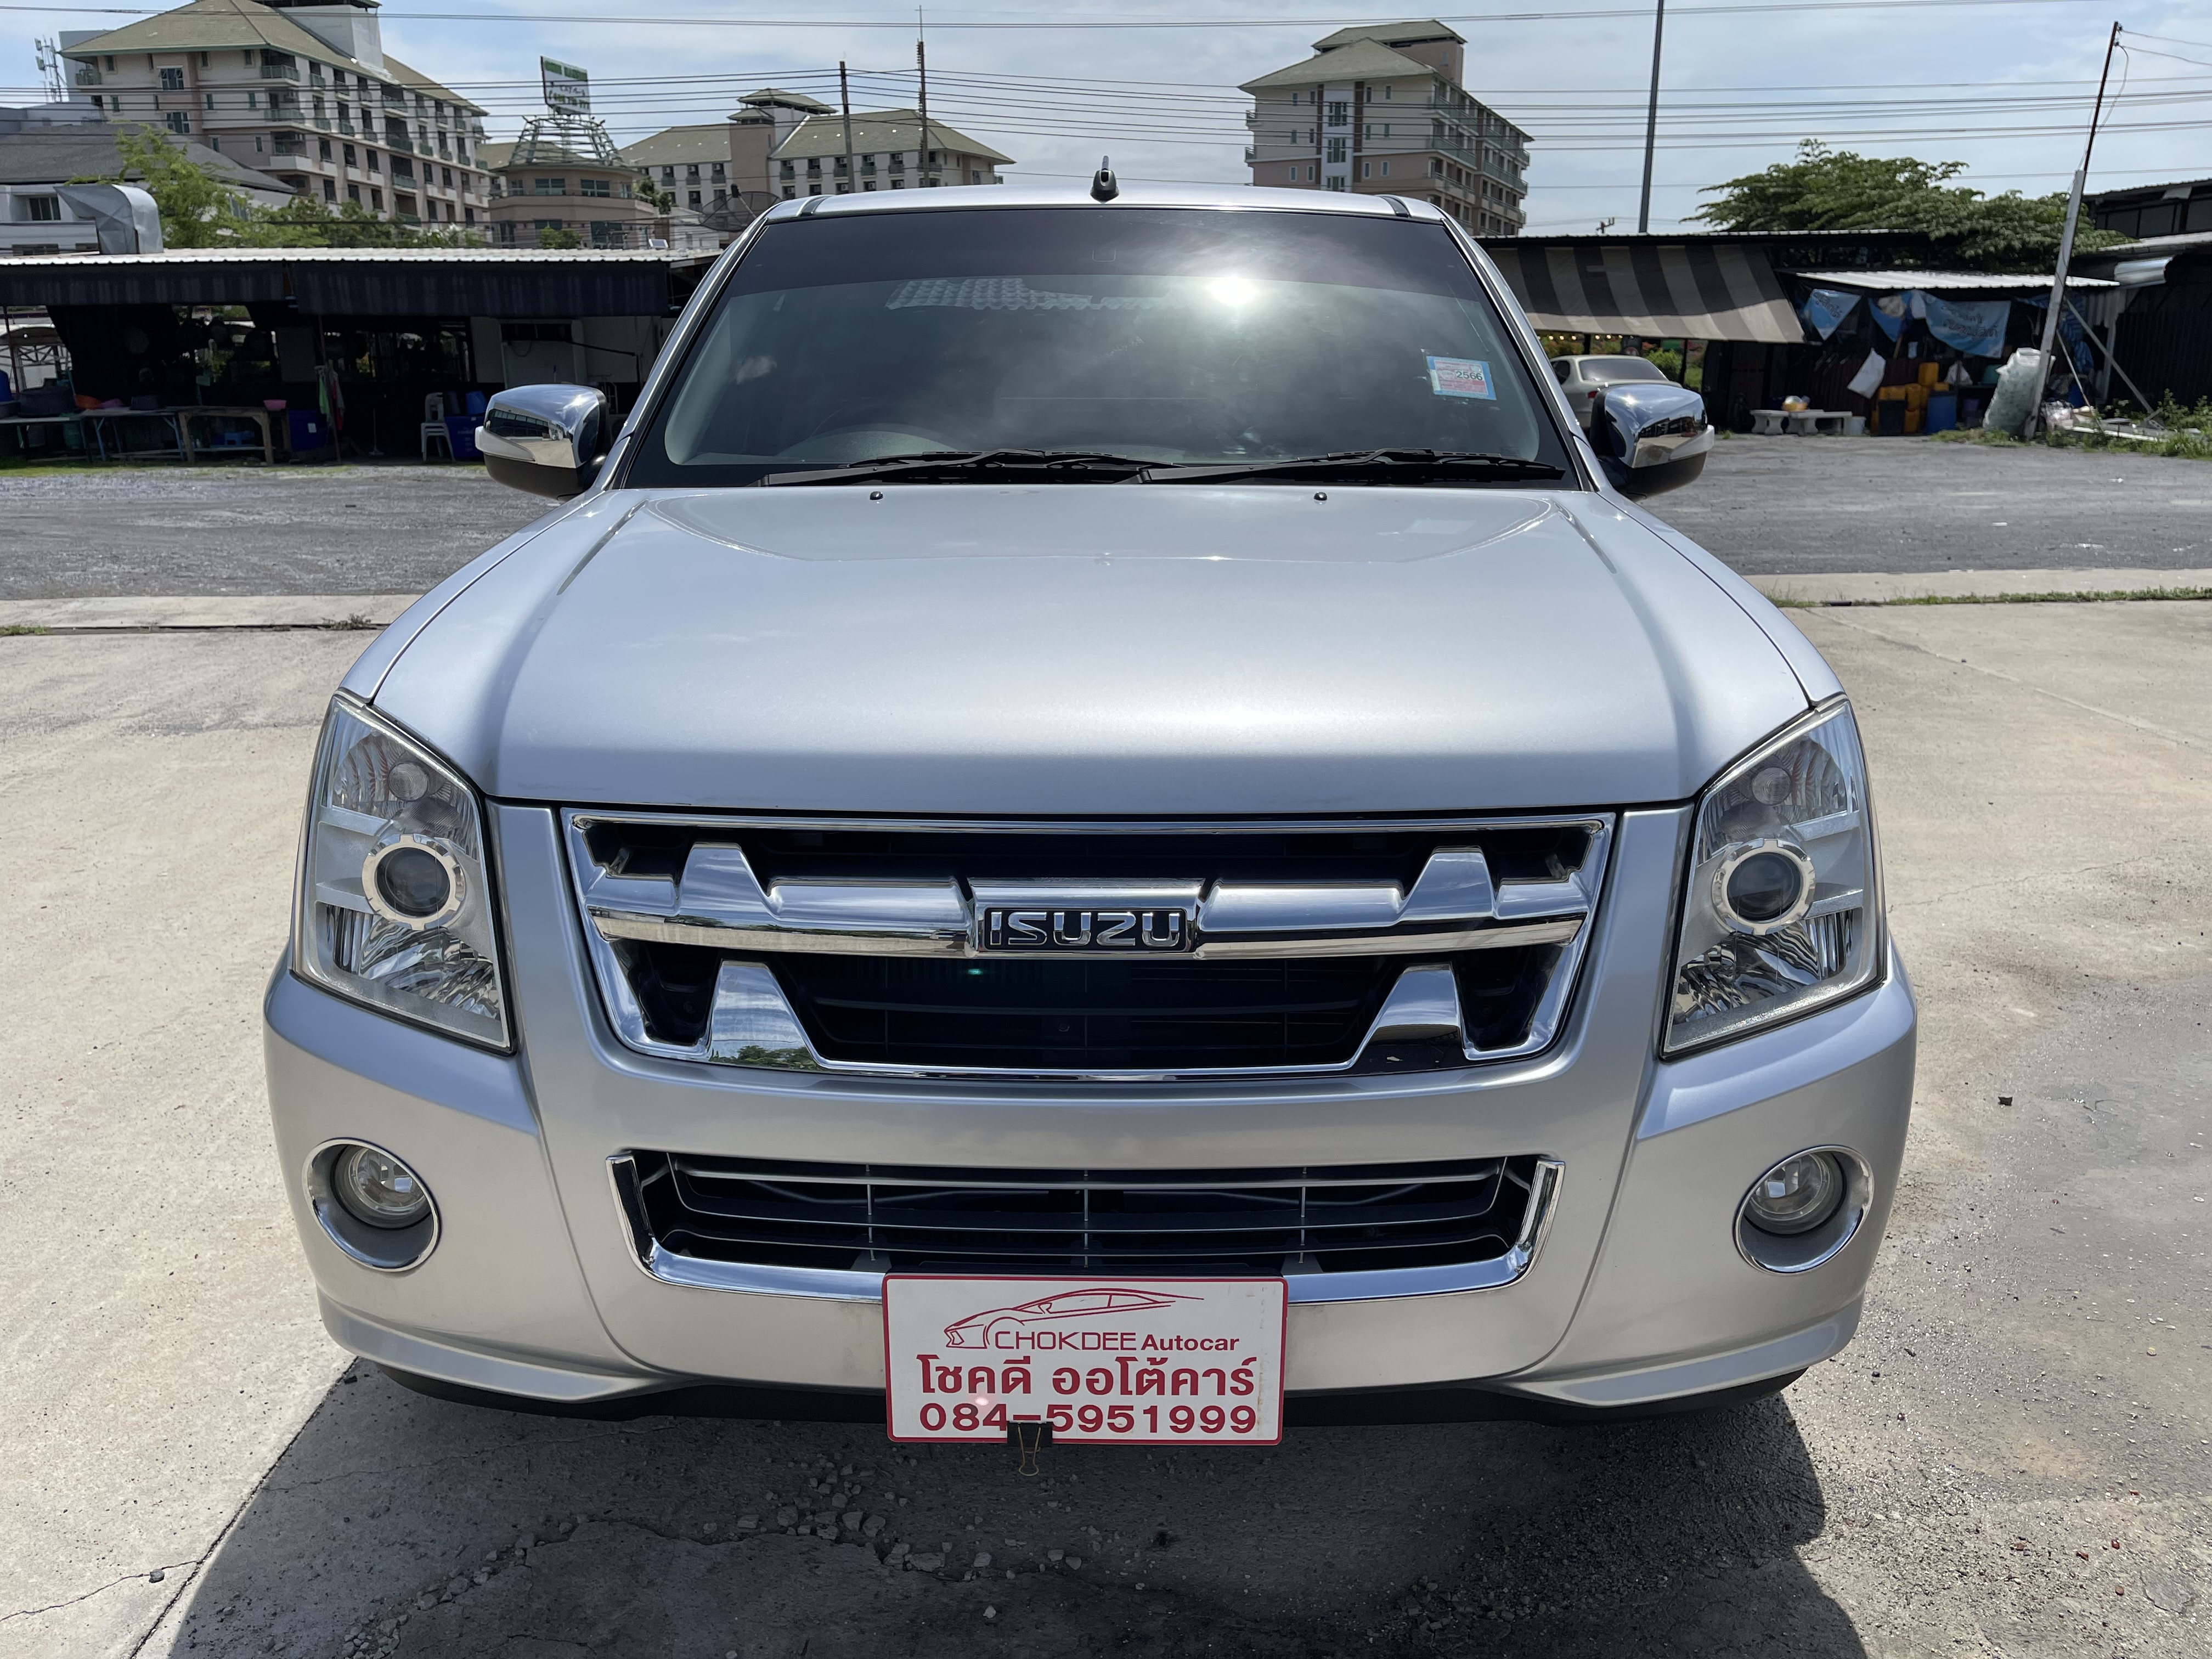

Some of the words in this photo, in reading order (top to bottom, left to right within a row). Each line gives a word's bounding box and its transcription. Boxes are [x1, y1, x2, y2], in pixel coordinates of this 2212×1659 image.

[1455, 371, 1483, 381] 2566
[989, 911, 1181, 947] ISUZU
[994, 1331, 1137, 1351] CHOKDEE
[1141, 1334, 1239, 1351] Autocar
[916, 1354, 1031, 1394] โชคดี
[1052, 1356, 1257, 1396] ออโต้คาร์
[919, 1403, 1256, 1434] 084-5951999
